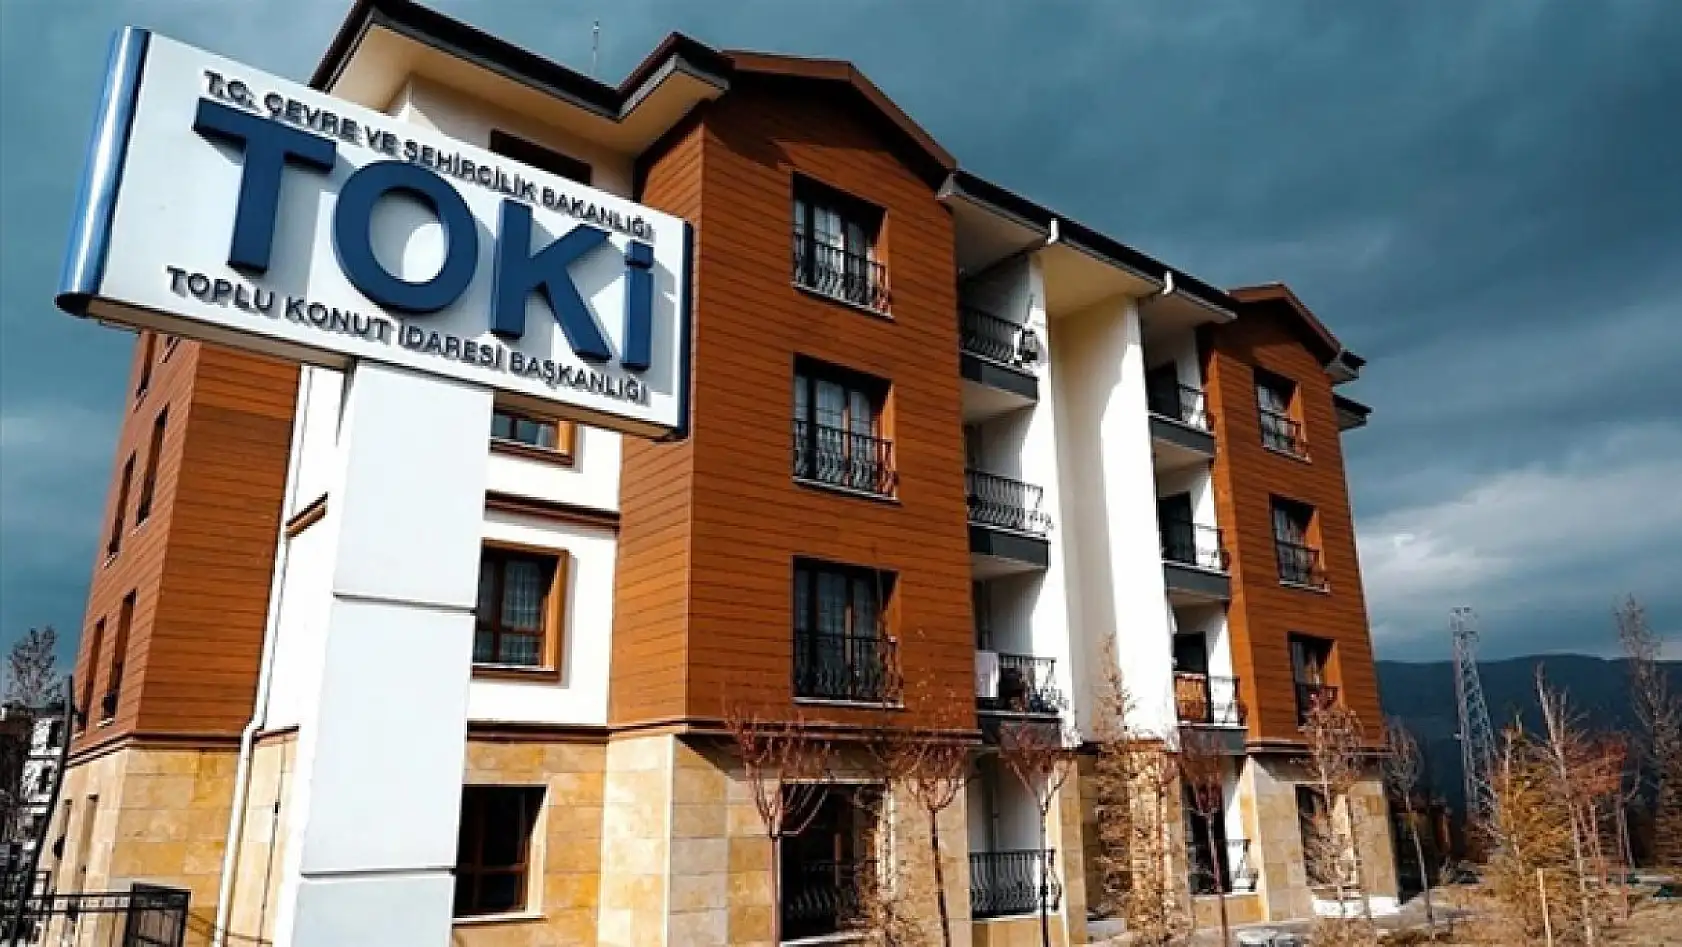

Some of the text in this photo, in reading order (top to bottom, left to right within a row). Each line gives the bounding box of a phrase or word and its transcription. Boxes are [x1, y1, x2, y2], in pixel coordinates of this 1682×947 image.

[364, 125, 400, 156] VE
[167, 265, 276, 314] TOPLU
[285, 295, 391, 342] KONUT
[510, 351, 648, 404] BAŞKANLIĞI
